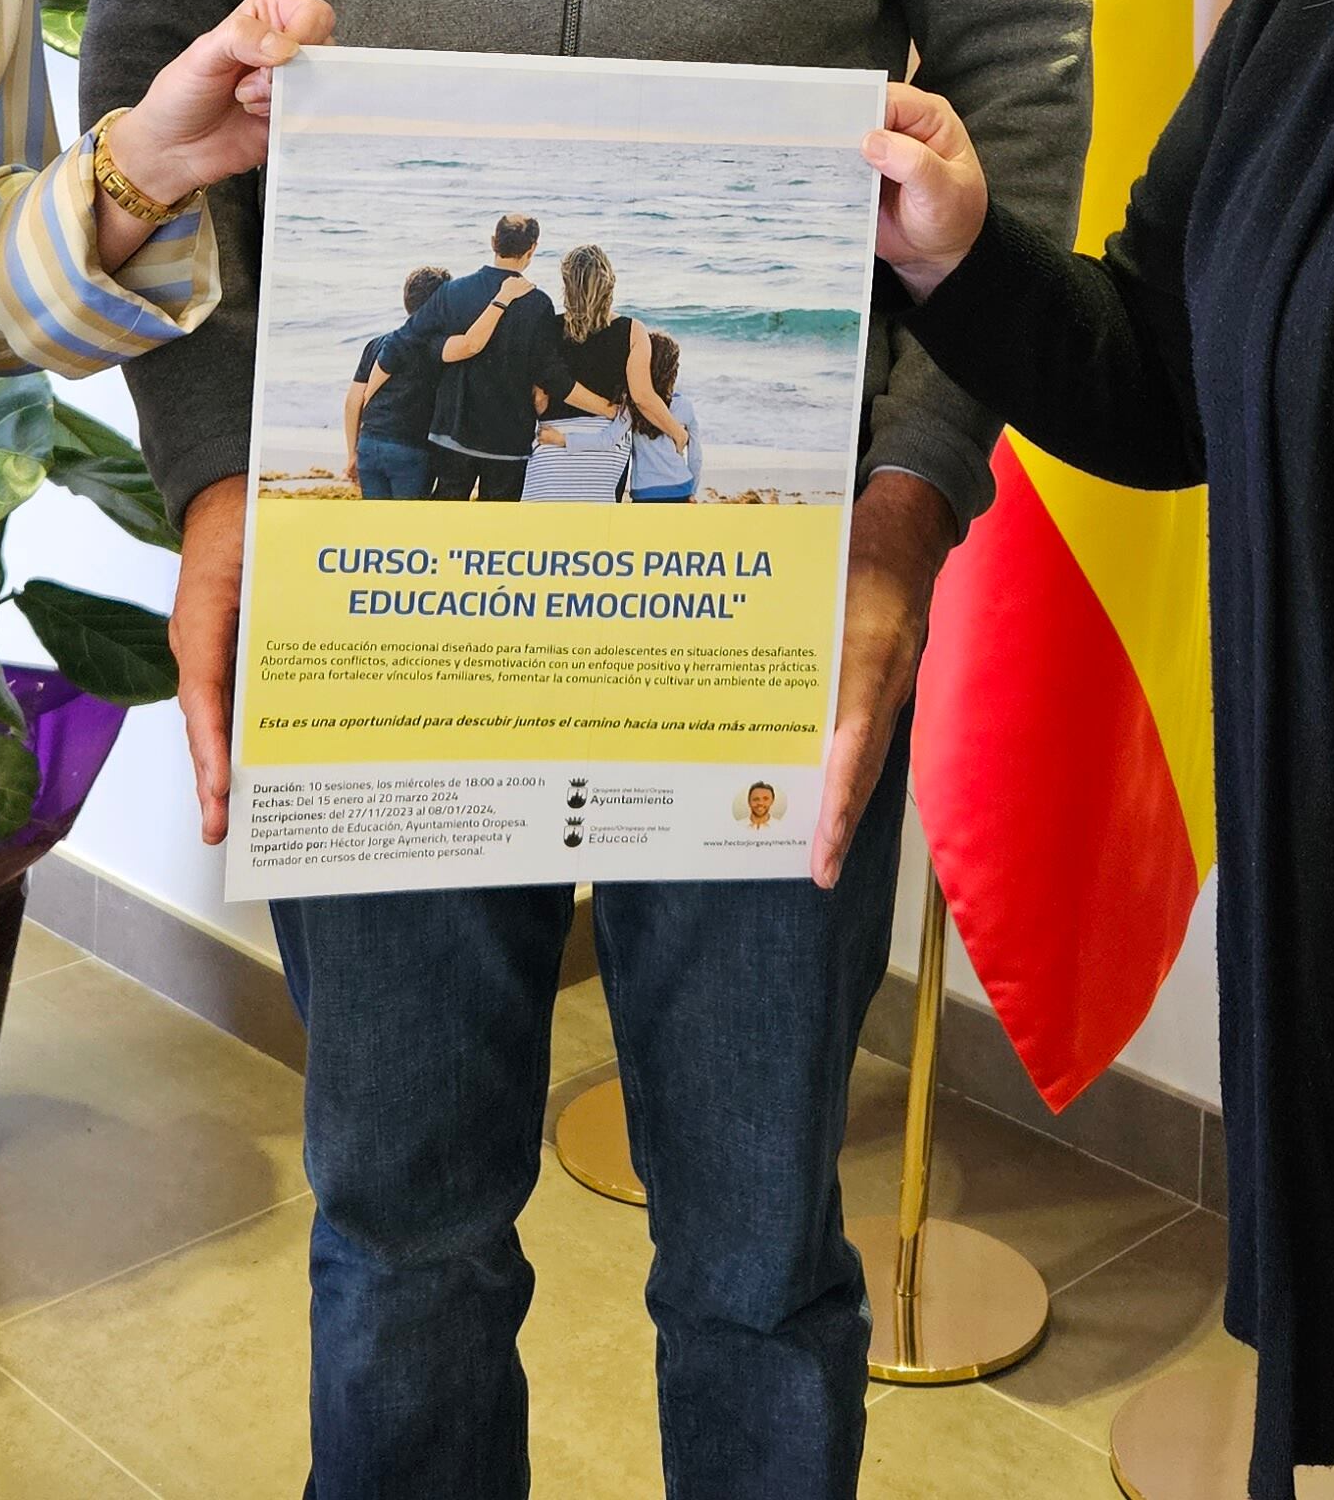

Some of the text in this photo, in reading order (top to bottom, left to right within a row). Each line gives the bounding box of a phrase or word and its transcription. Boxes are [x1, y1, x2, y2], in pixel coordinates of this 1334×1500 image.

[318, 548, 772, 577] CURSO: "RECURSOS PARA LA
[348, 585, 746, 618] EDUCACIÓN EMOCIONAL"
[267, 641, 817, 657] Curso de educación emocional diseñado para familias con adolescentes en situaciones desafiantes.
[261, 656, 819, 674] Abordamos conflictos, adicciones y desmotivación con un enfoque positivo y herramientas prácticas.
[262, 669, 819, 689] Únete para fortalecer vínculos familiares, fomentar la comunicación y cultivar un ambiente de apoyo.
[259, 715, 818, 733] Esta es una oportunidad para descubir juntos el camino hacia una vida más armoniosa.
[253, 782, 305, 794] Duración:
[309, 782, 321, 792] 10
[325, 781, 373, 792] sesiones,
[377, 780, 392, 789] los
[395, 778, 445, 788] miércoles
[448, 778, 461, 788] de
[539, 778, 545, 786] h
[253, 792, 459, 808] Fechas: Del 15 enero al 20 marzo 2024
[590, 795, 673, 806] Ayuntamiento
[251, 812, 326, 824] Inscripciones:
[329, 809, 345, 820] del
[347, 807, 413, 819] 27/11/2023
[416, 806, 425, 816] al
[251, 826, 329, 839] Departamento
[331, 824, 345, 834] de
[347, 821, 403, 834] Educación,
[406, 819, 479, 832] Ayuntamiento
[589, 833, 648, 843] Educació
[251, 832, 511, 854] Impartido por: Héctor Jorge Aymerich, terapeuta y
[253, 846, 485, 868] formador en cursos de crecimiento personal.
